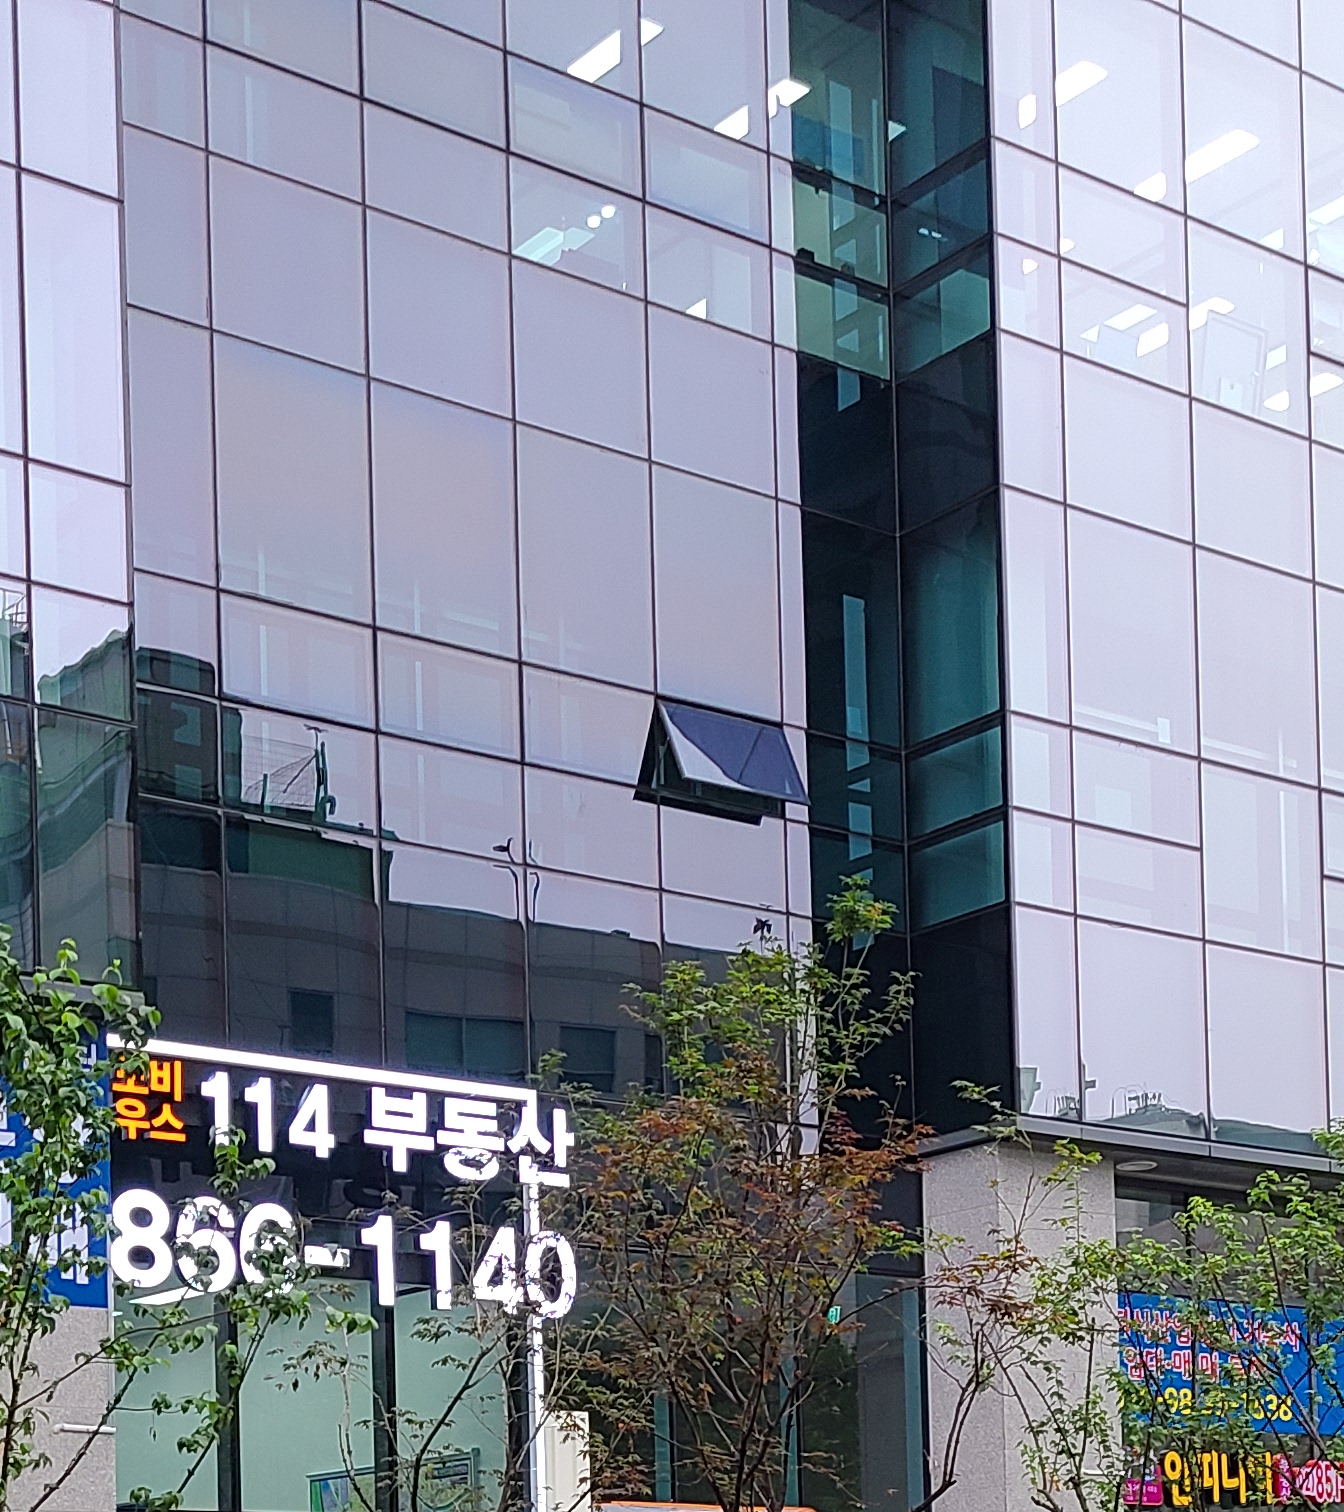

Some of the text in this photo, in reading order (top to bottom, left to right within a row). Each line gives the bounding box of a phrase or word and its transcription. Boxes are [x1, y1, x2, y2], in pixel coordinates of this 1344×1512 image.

[113, 1099, 187, 1143] 우스
[201, 1070, 575, 1188] 114 부동산
